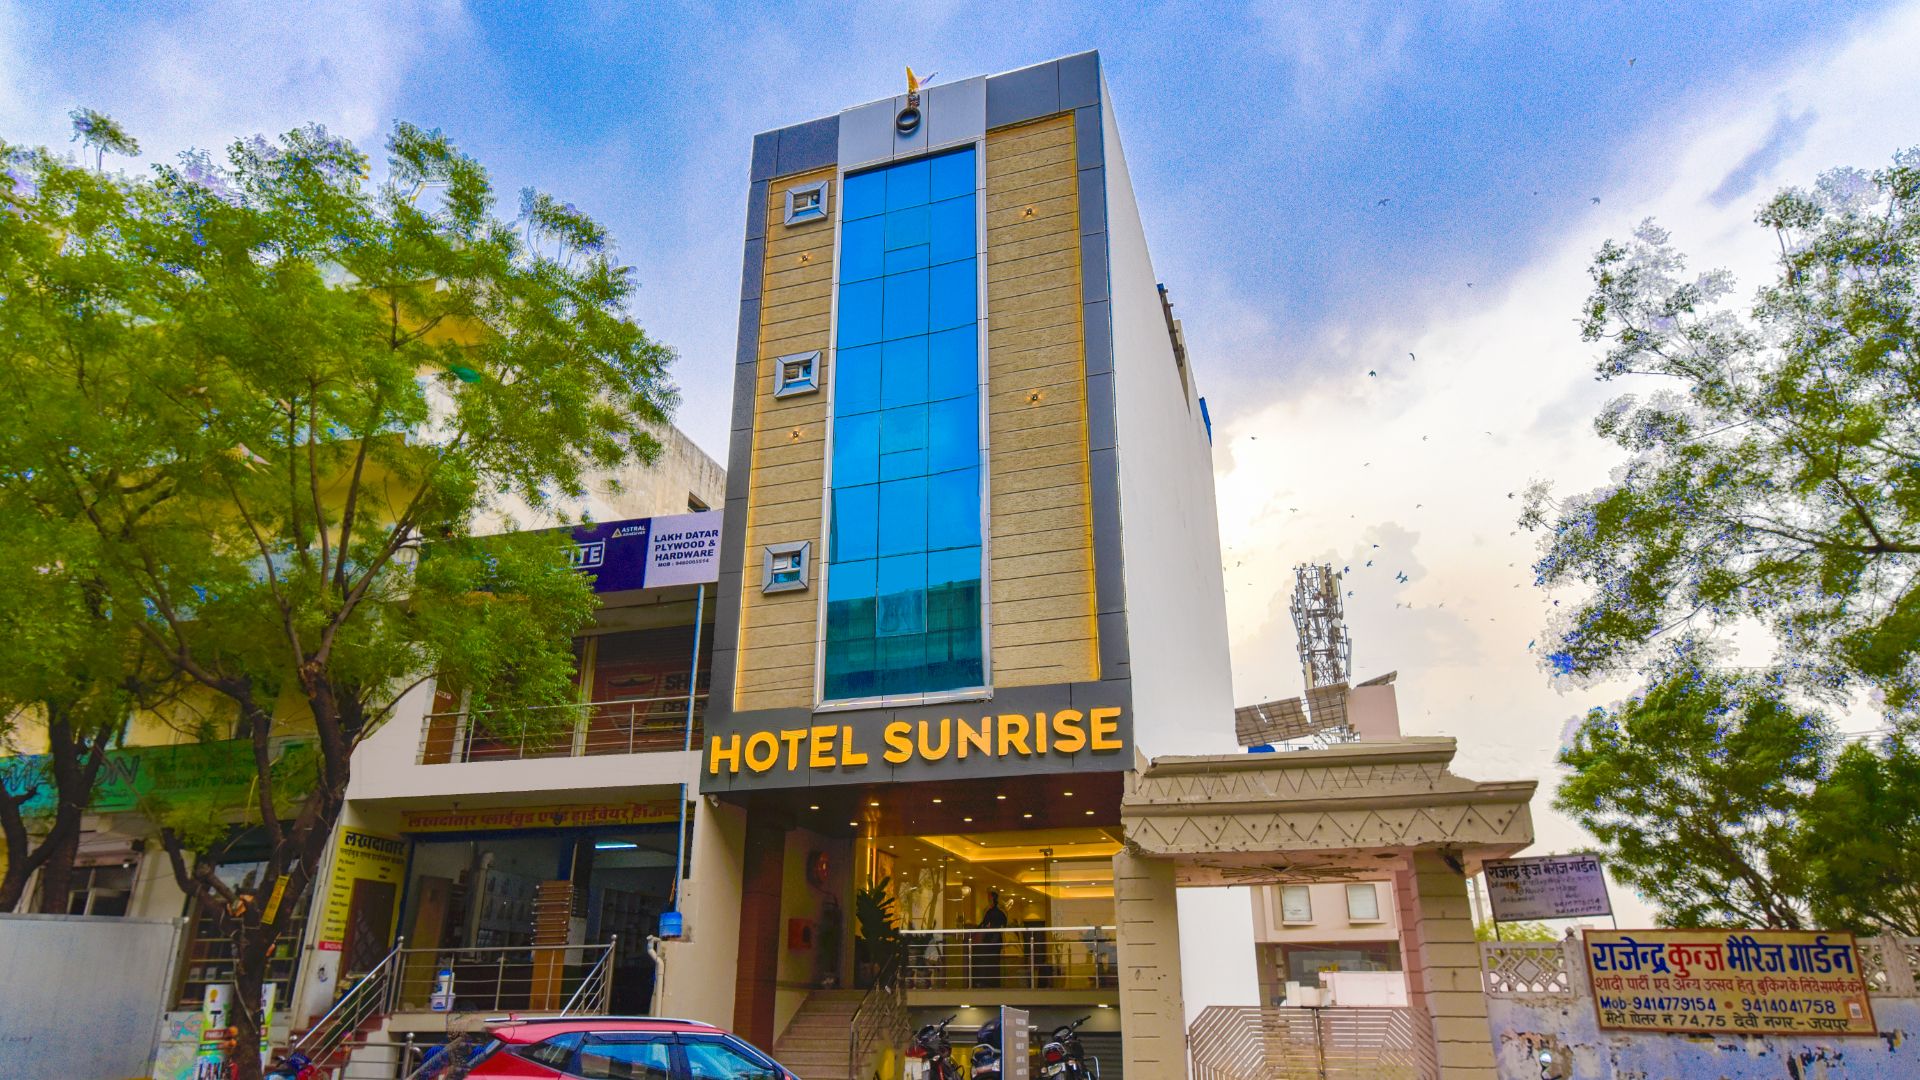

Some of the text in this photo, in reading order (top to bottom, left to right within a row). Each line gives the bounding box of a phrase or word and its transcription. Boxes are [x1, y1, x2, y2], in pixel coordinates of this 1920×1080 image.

[621, 525, 646, 533] ASTRAL
[654, 529, 719, 543] LAKH DATAR
[655, 539, 716, 551] PLYWOOD &
[655, 549, 714, 561] HARDWARE
[709, 706, 1123, 775] HOTEL SUNRISE
[1590, 936, 1671, 974] राजेन्द्र
[1726, 934, 1786, 973] मैरिज
[1786, 935, 1854, 974] गार्डन
[1595, 974, 1624, 992] शादी
[1626, 974, 1649, 991] पार्टी
[1671, 977, 1701, 992] अन्य
[1703, 977, 1734, 992] उत्सव
[1735, 976, 1756, 995] हेतु
[1741, 998, 1837, 1015] 9414041758
[1733, 1011, 1759, 1029] देवी
